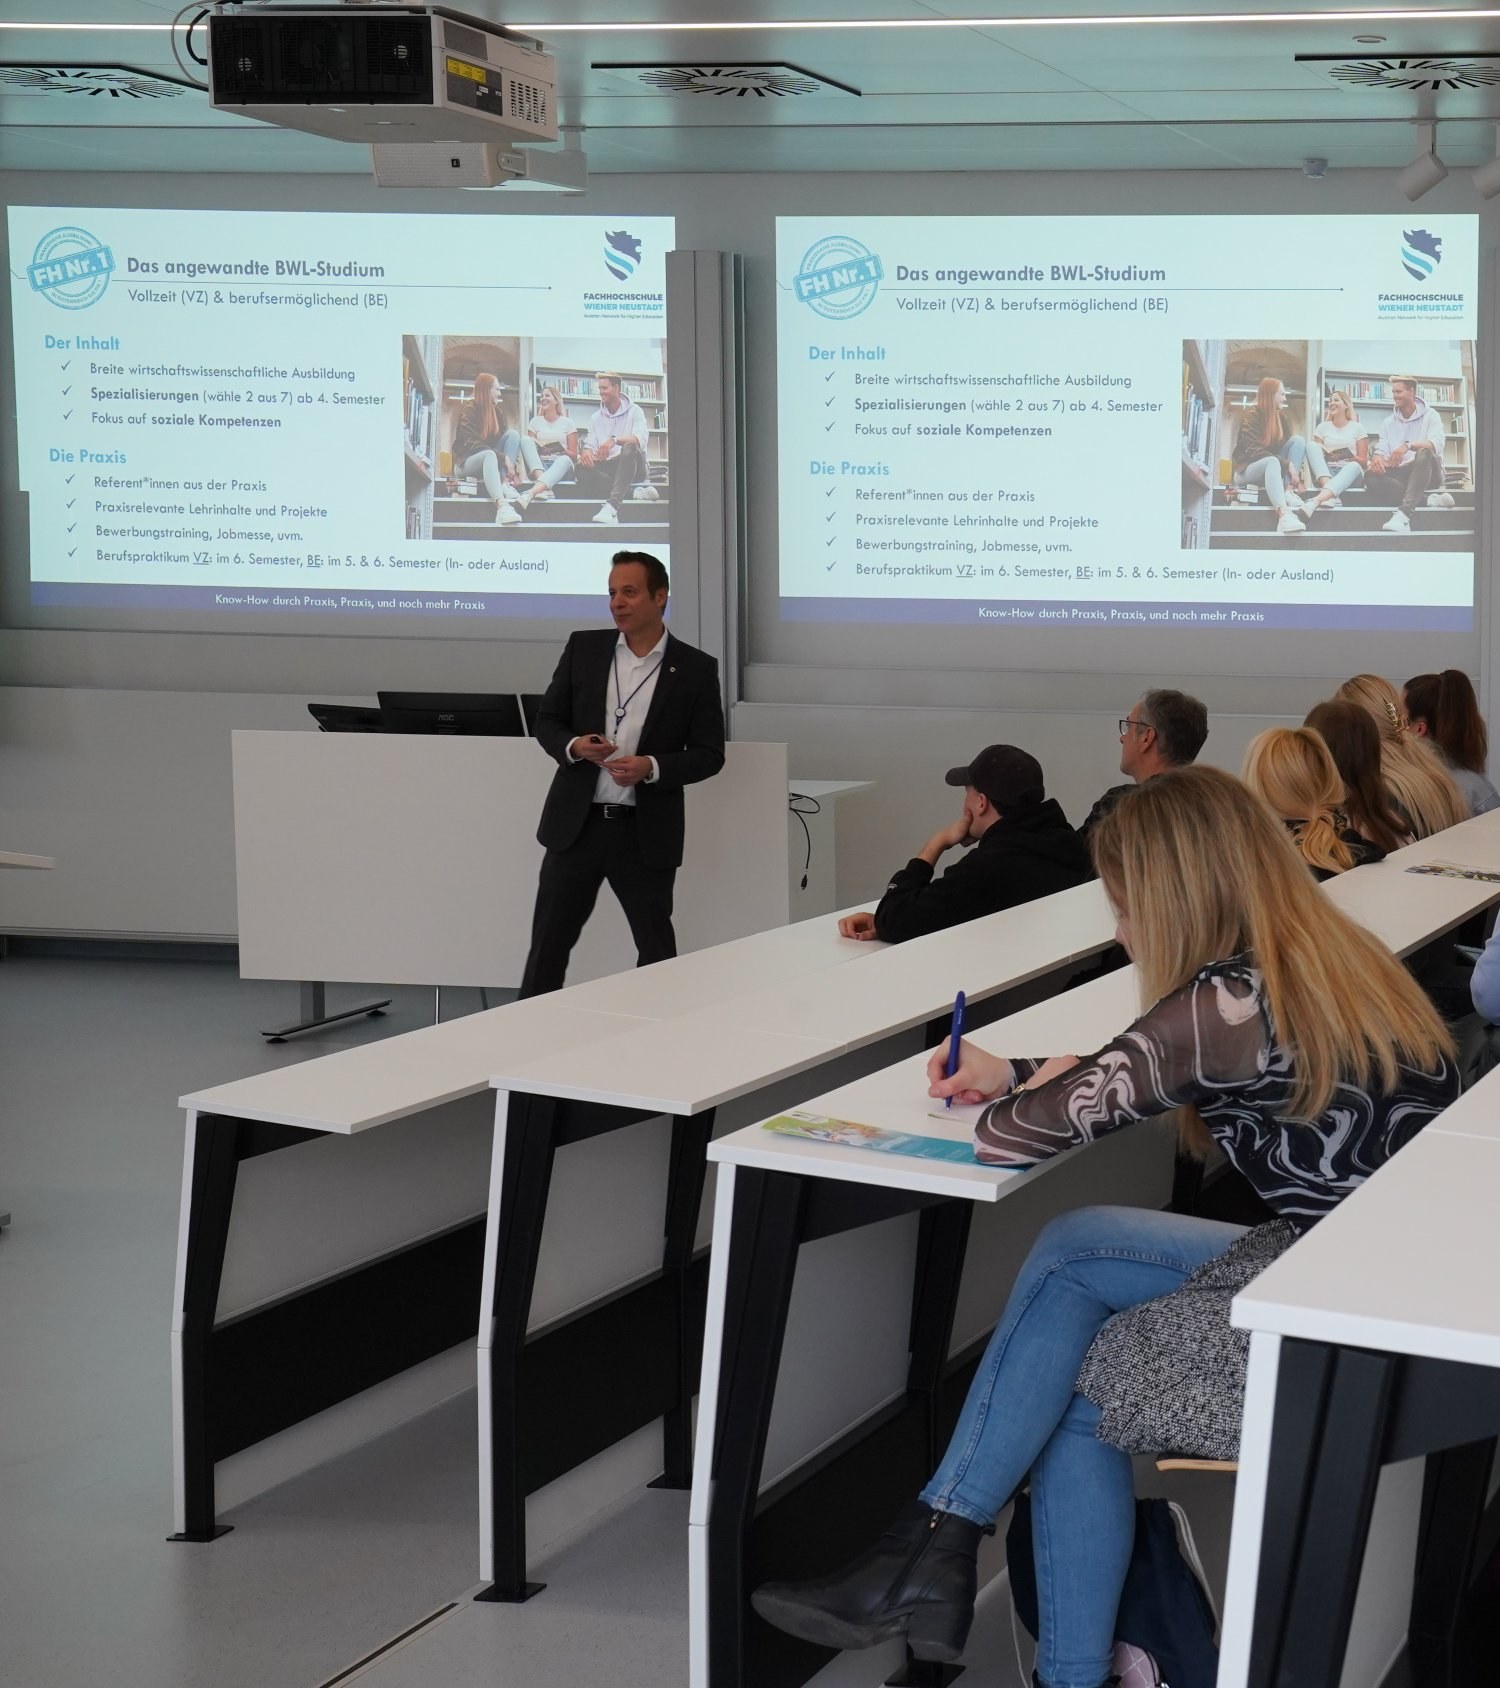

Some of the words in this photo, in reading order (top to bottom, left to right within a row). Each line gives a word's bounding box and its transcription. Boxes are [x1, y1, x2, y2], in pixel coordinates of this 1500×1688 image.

[33, 264, 63, 286] FH
[64, 259, 97, 278] Nr.
[97, 252, 109, 269] 1
[127, 258, 159, 275] Das
[164, 259, 270, 278] angewandte
[275, 259, 385, 278] BWL-Studium
[896, 265, 929, 282] Das
[935, 265, 1045, 285] angewandte
[1050, 264, 1166, 282] BWL-Studium
[800, 274, 830, 297] FH
[832, 268, 865, 289] Nr.
[865, 261, 877, 277] 1
[127, 288, 177, 303] Vollzeit
[181, 289, 209, 306] (VZ)
[213, 290, 225, 304] &
[229, 291, 359, 309] berufsermöglichend
[363, 293, 388, 310] (BE)
[583, 293, 663, 301] FACHHOCHSCHULE
[895, 297, 947, 311] Vollzeit
[951, 297, 980, 314] (VZ)
[984, 297, 996, 311] &
[1001, 297, 1138, 314] berufsermöglichend
[1143, 297, 1169, 314] (BE)
[619, 303, 663, 311] NEUSTADT
[44, 334, 72, 350] Der
[76, 335, 121, 351] Inhalt
[808, 345, 836, 361] Der
[840, 345, 887, 361] Inhalt
[90, 362, 125, 375] Breite
[128, 363, 288, 379] wirtschaftswissenschaftliche
[291, 367, 355, 383] Ausbildung
[855, 373, 890, 385] Breite
[894, 373, 1061, 386] wirtschaftswissenschaftliche
[1064, 374, 1132, 389] Ausbildung
[90, 386, 199, 404] Spezialisierungen
[203, 389, 242, 404] (wähle
[245, 390, 254, 403] 2
[257, 394, 277, 403] aus
[280, 391, 293, 406] 7)
[296, 392, 313, 404] ab
[316, 392, 329, 404] 4.
[332, 392, 386, 405] Semester
[854, 397, 967, 414] Spezialisierungen
[970, 399, 1011, 414] (wähle
[1015, 398, 1024, 411] 2
[1027, 402, 1049, 412] aus
[1052, 399, 1065, 414] 7)
[1069, 399, 1087, 412] ab
[1090, 400, 1103, 411] 4.
[1107, 399, 1164, 412] Semester
[91, 411, 124, 424] Fokus
[127, 412, 147, 425] auf
[151, 413, 195, 426] soziale
[198, 413, 282, 429] Kompetenzen
[855, 423, 888, 436] Fokus
[891, 423, 912, 436] auf
[916, 423, 962, 436] soziale
[965, 423, 1052, 439] Kompetenzen
[49, 447, 75, 463] Die
[79, 448, 127, 464] Praxis
[809, 460, 836, 476] Die
[840, 460, 890, 476] Praxis
[183, 481, 203, 491] aus
[206, 478, 228, 491] der
[231, 479, 267, 492] Praxis
[947, 492, 969, 502] aus
[972, 489, 994, 502] der
[998, 489, 1035, 502] Praxis
[95, 500, 185, 515] Praxisrelevante
[189, 503, 252, 516] Lehrinhalte
[255, 504, 277, 517] und
[280, 504, 328, 520] Projekte
[855, 513, 949, 527] Praxisrelevante
[953, 514, 1019, 527] Lehrinhalte
[1022, 515, 1045, 528] und
[1049, 515, 1099, 531] Projekte
[95, 524, 213, 542] Bewerbungstraining,
[216, 527, 274, 543] Jobmesse,
[277, 532, 303, 541] uvm.
[856, 538, 977, 554] Bewerbungstraining,
[981, 539, 1042, 555] Jobmesse,
[1045, 543, 1073, 553] uvm.
[96, 548, 190, 565] Berufspraktikum
[192, 551, 213, 566] VZ:
[216, 552, 230, 564] im
[233, 552, 245, 565] 6.
[248, 552, 304, 569] Semester,
[306, 554, 324, 569] BE:
[327, 555, 341, 567] im
[344, 555, 356, 567] 5.
[359, 555, 370, 568] &
[373, 555, 385, 568] 6.
[388, 555, 442, 569] Semester
[445, 557, 464, 572] (In-
[467, 558, 496, 570] oder
[498, 558, 549, 574] Ausland)
[855, 562, 953, 579] Berufspraktikum
[955, 564, 977, 579] VZ:
[980, 565, 994, 577] im
[998, 564, 1010, 577] 6.
[1014, 564, 1072, 581] Semester,
[1074, 565, 1094, 580] BE:
[1097, 566, 1112, 578] im
[1115, 566, 1128, 579] 5.
[1131, 566, 1142, 579] &
[1146, 566, 1158, 579] 6.
[1162, 566, 1219, 580] Semester
[1222, 567, 1242, 582] (In-
[1246, 568, 1277, 580] oder
[1279, 568, 1334, 584] Ausland)
[215, 593, 270, 605] Know-How
[272, 595, 301, 606] durch
[303, 595, 338, 609] Praxis,
[340, 596, 375, 610] Praxis,
[377, 597, 396, 608] und
[399, 598, 423, 609] noch
[425, 599, 452, 609] mehr
[454, 599, 486, 610] Praxis
[978, 607, 1035, 618] Know-How
[1038, 607, 1069, 619] durch
[1071, 608, 1108, 621] Praxis,
[1110, 609, 1147, 622] Praxis,
[1149, 609, 1169, 620] und
[1172, 609, 1198, 621] noch
[1200, 610, 1228, 621] mehr
[1231, 610, 1265, 622] Praxis
